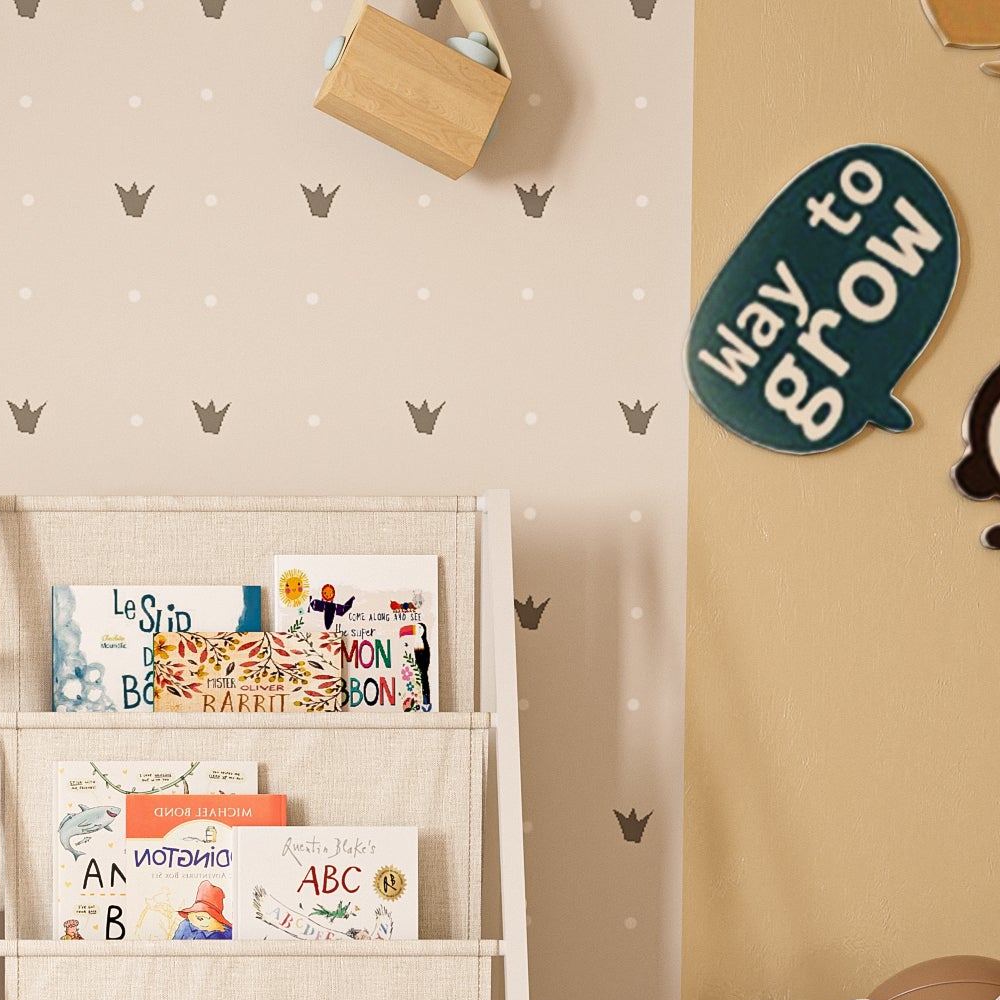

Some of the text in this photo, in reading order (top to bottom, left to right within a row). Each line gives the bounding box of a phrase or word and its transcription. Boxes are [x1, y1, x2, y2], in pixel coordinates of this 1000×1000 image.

[698, 159, 883, 385] way to
[765, 196, 942, 441] grow
[113, 589, 136, 620] Le
[369, 613, 390, 621] ALONG
[394, 613, 406, 621] AND
[410, 613, 422, 621] SEE
[207, 677, 236, 689] MISTER
[282, 836, 376, 866] Quentin Blake's
[297, 865, 361, 895] ABC
